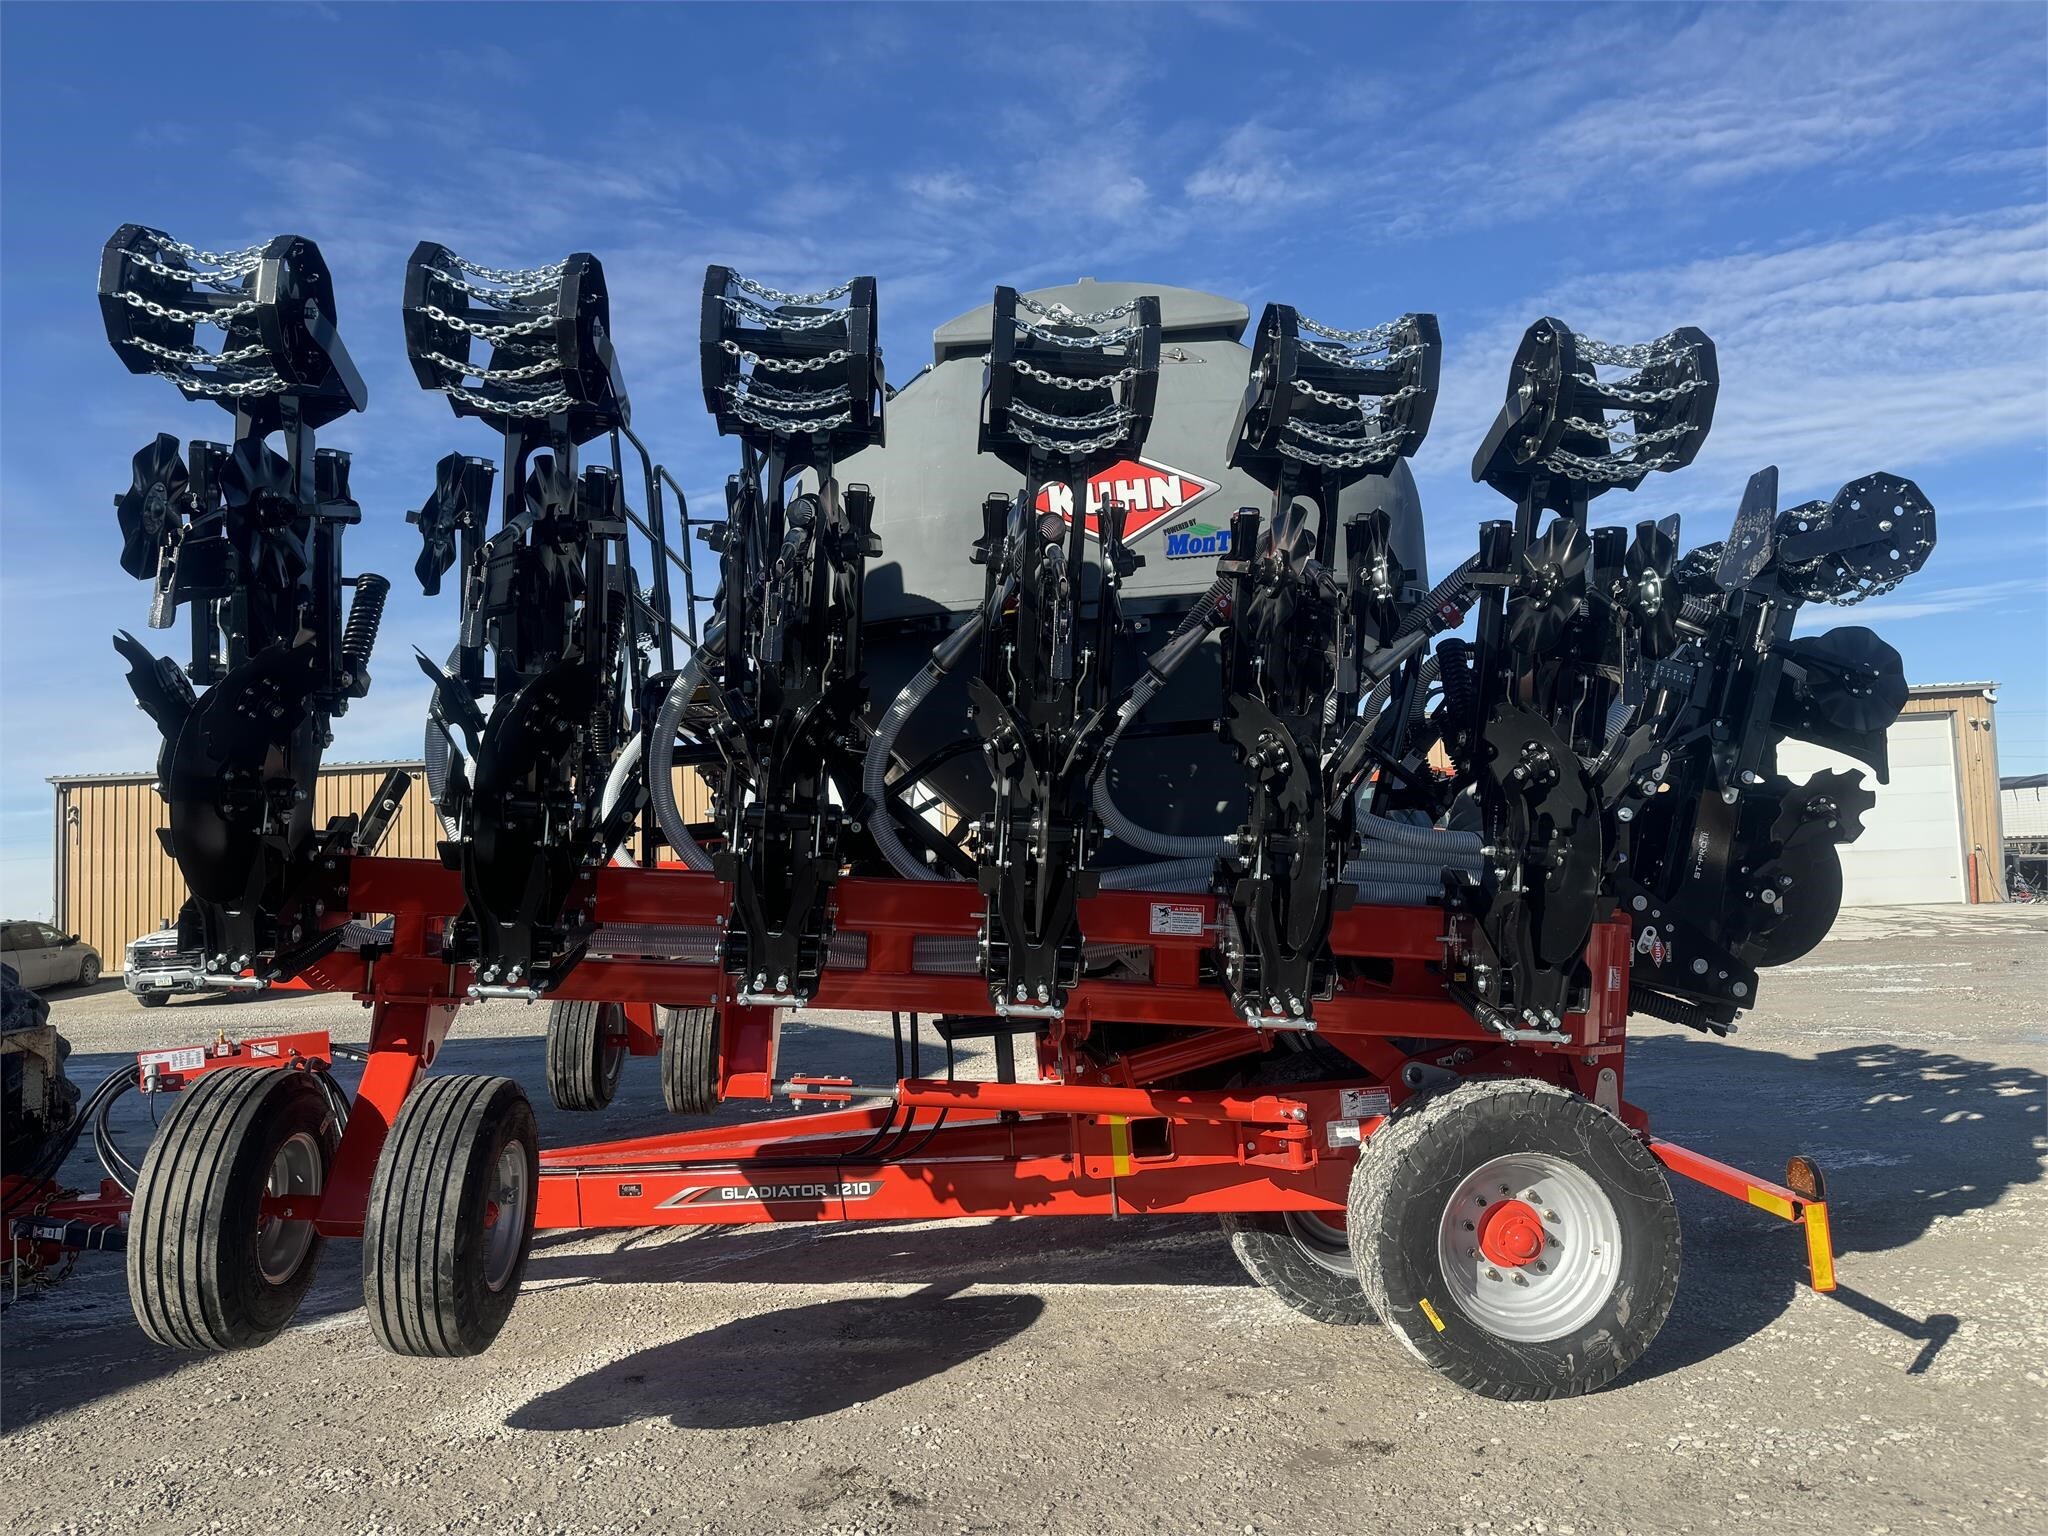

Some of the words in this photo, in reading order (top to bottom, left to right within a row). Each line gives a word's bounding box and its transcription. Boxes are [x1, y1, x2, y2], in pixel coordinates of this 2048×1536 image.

[1047, 475, 1183, 516] KUHN
[1163, 522, 1188, 536] POWERED
[1188, 518, 1197, 528] BY
[721, 1184, 827, 1200] GLADIATOR
[834, 1182, 871, 1196] 1210
